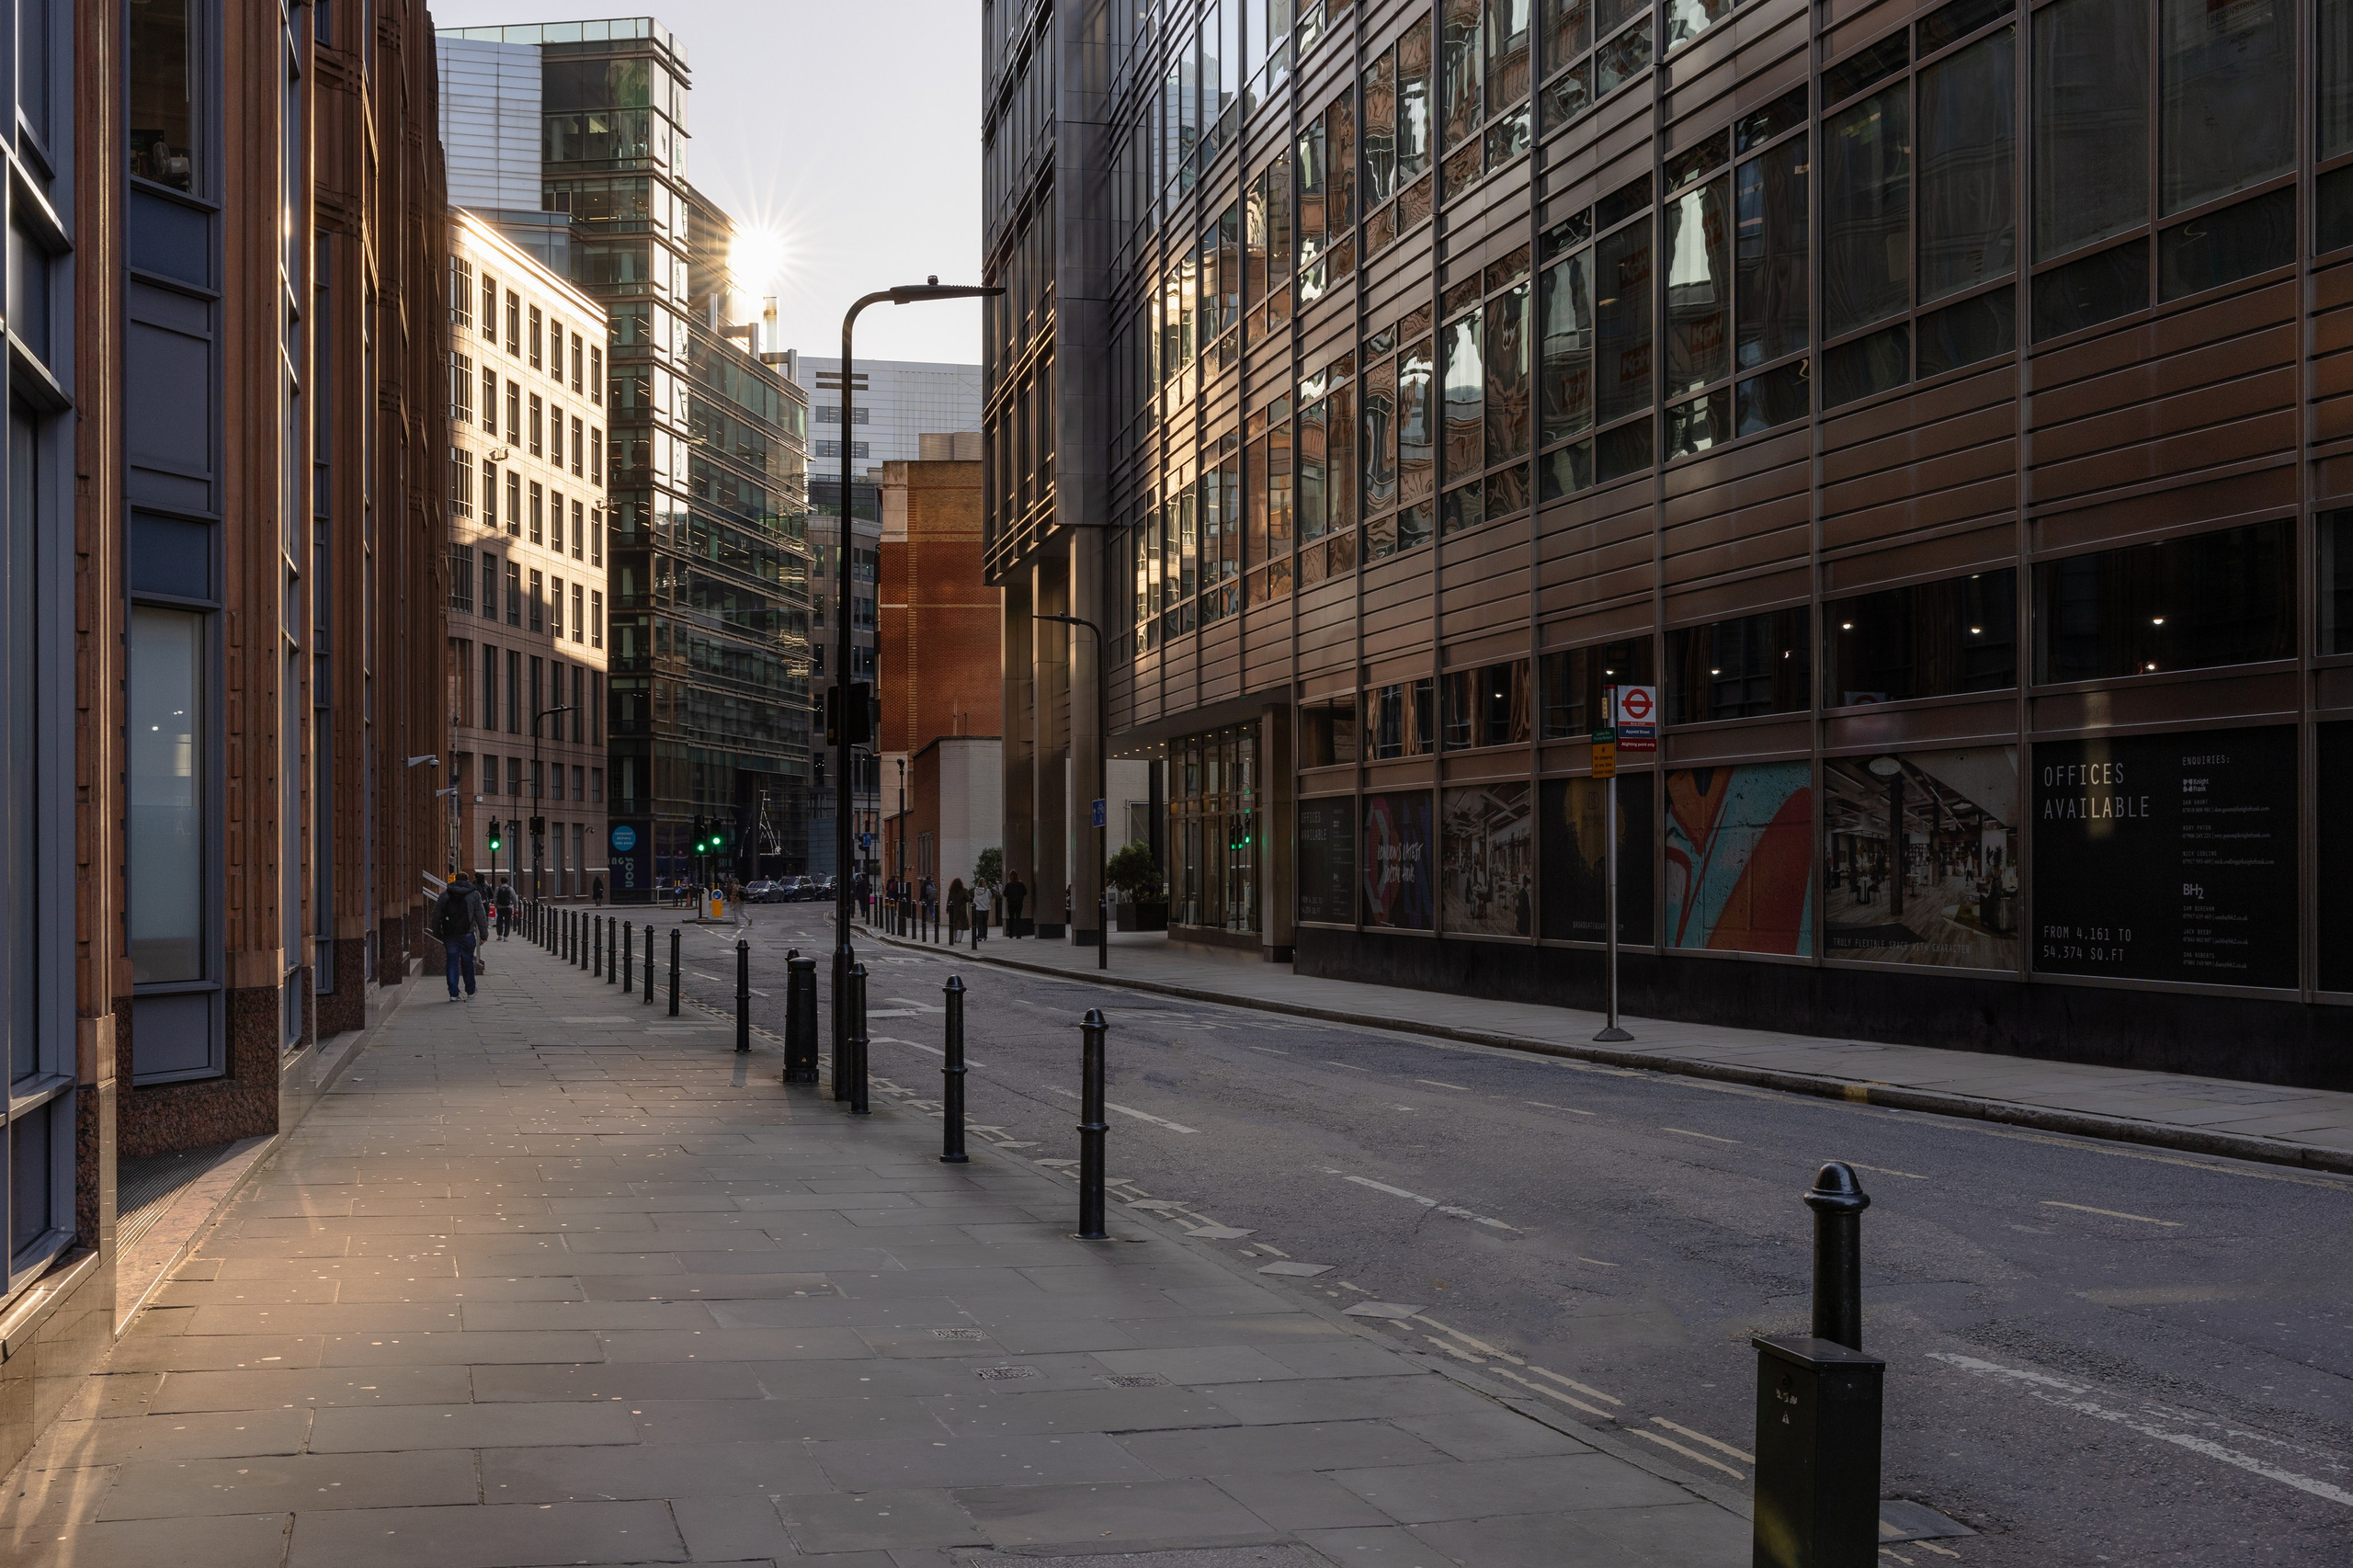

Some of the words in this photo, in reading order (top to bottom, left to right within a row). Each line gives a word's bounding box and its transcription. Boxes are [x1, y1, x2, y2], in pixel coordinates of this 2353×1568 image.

[2183, 755, 2230, 766] ENQUIRIES:
[2044, 763, 2123, 787] OFFICES
[2044, 796, 2149, 819] AVAILABLE
[1302, 811, 1321, 824] OFFICES
[1302, 828, 1326, 841] AVAILABLE
[1403, 842, 1424, 862] LATEST
[2183, 883, 2204, 900] BH2
[1573, 921, 1624, 931] BROADGATEQUAROM
[2043, 926, 2069, 938] FROM
[2076, 927, 2110, 941] 4,161
[2118, 928, 2131, 942] TO
[1834, 937, 1851, 947] TRULY
[1855, 938, 1885, 949] FLEXIBLE
[1889, 941, 1908, 950] SPACE
[1912, 942, 1928, 951] WITH
[1932, 943, 1971, 954] CHARACTER
[2043, 945, 2083, 960] 54,374
[2090, 948, 2124, 962] SQ.FT
